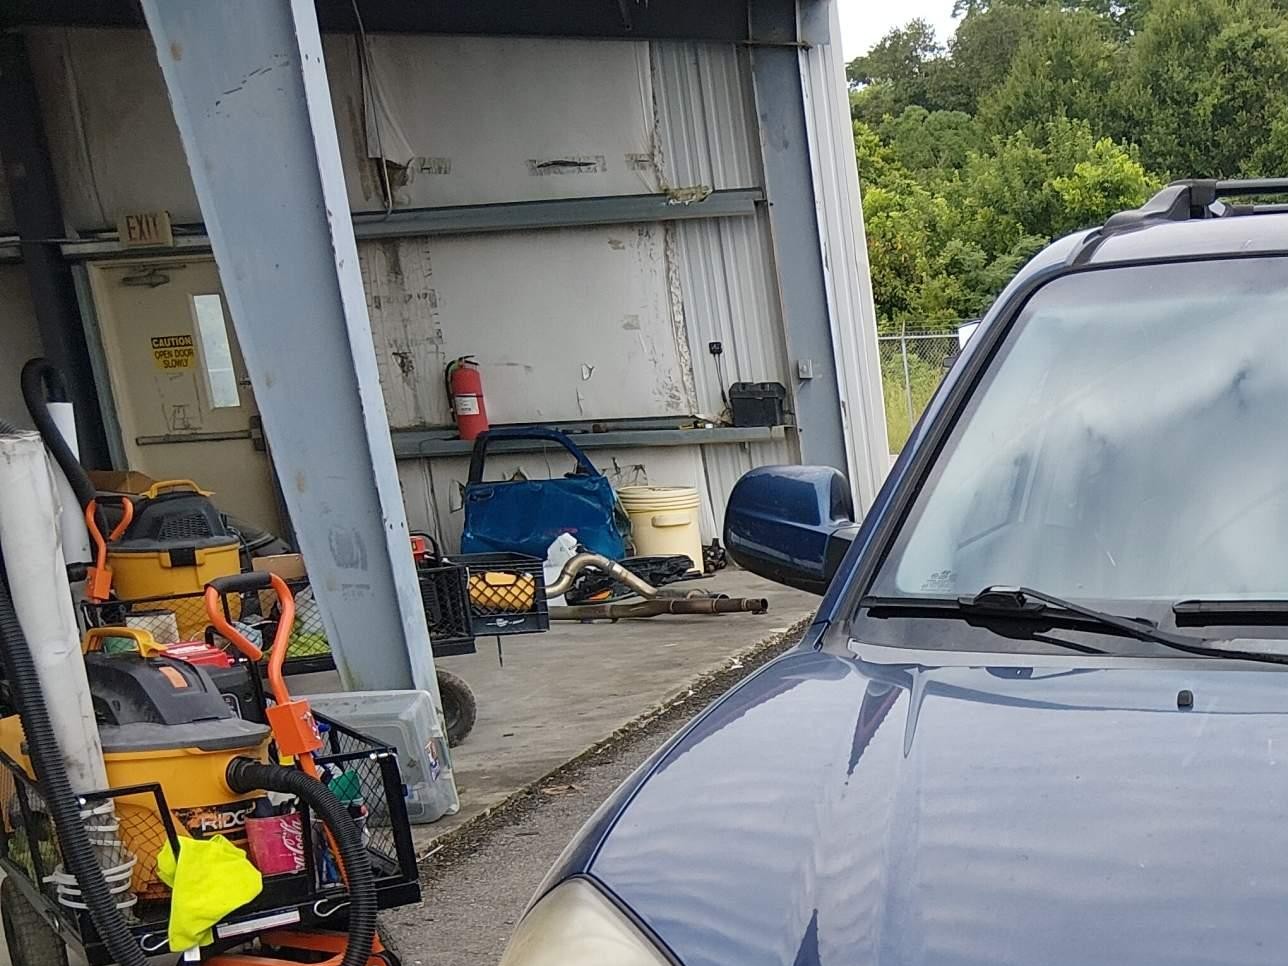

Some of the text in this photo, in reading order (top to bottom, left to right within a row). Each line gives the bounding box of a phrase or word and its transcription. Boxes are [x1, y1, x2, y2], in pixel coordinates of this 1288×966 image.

[126, 213, 161, 241] EXIT
[152, 336, 192, 348] CAUTION
[154, 348, 194, 360] OPEN DOOR
[162, 359, 189, 369] SLOWLY
